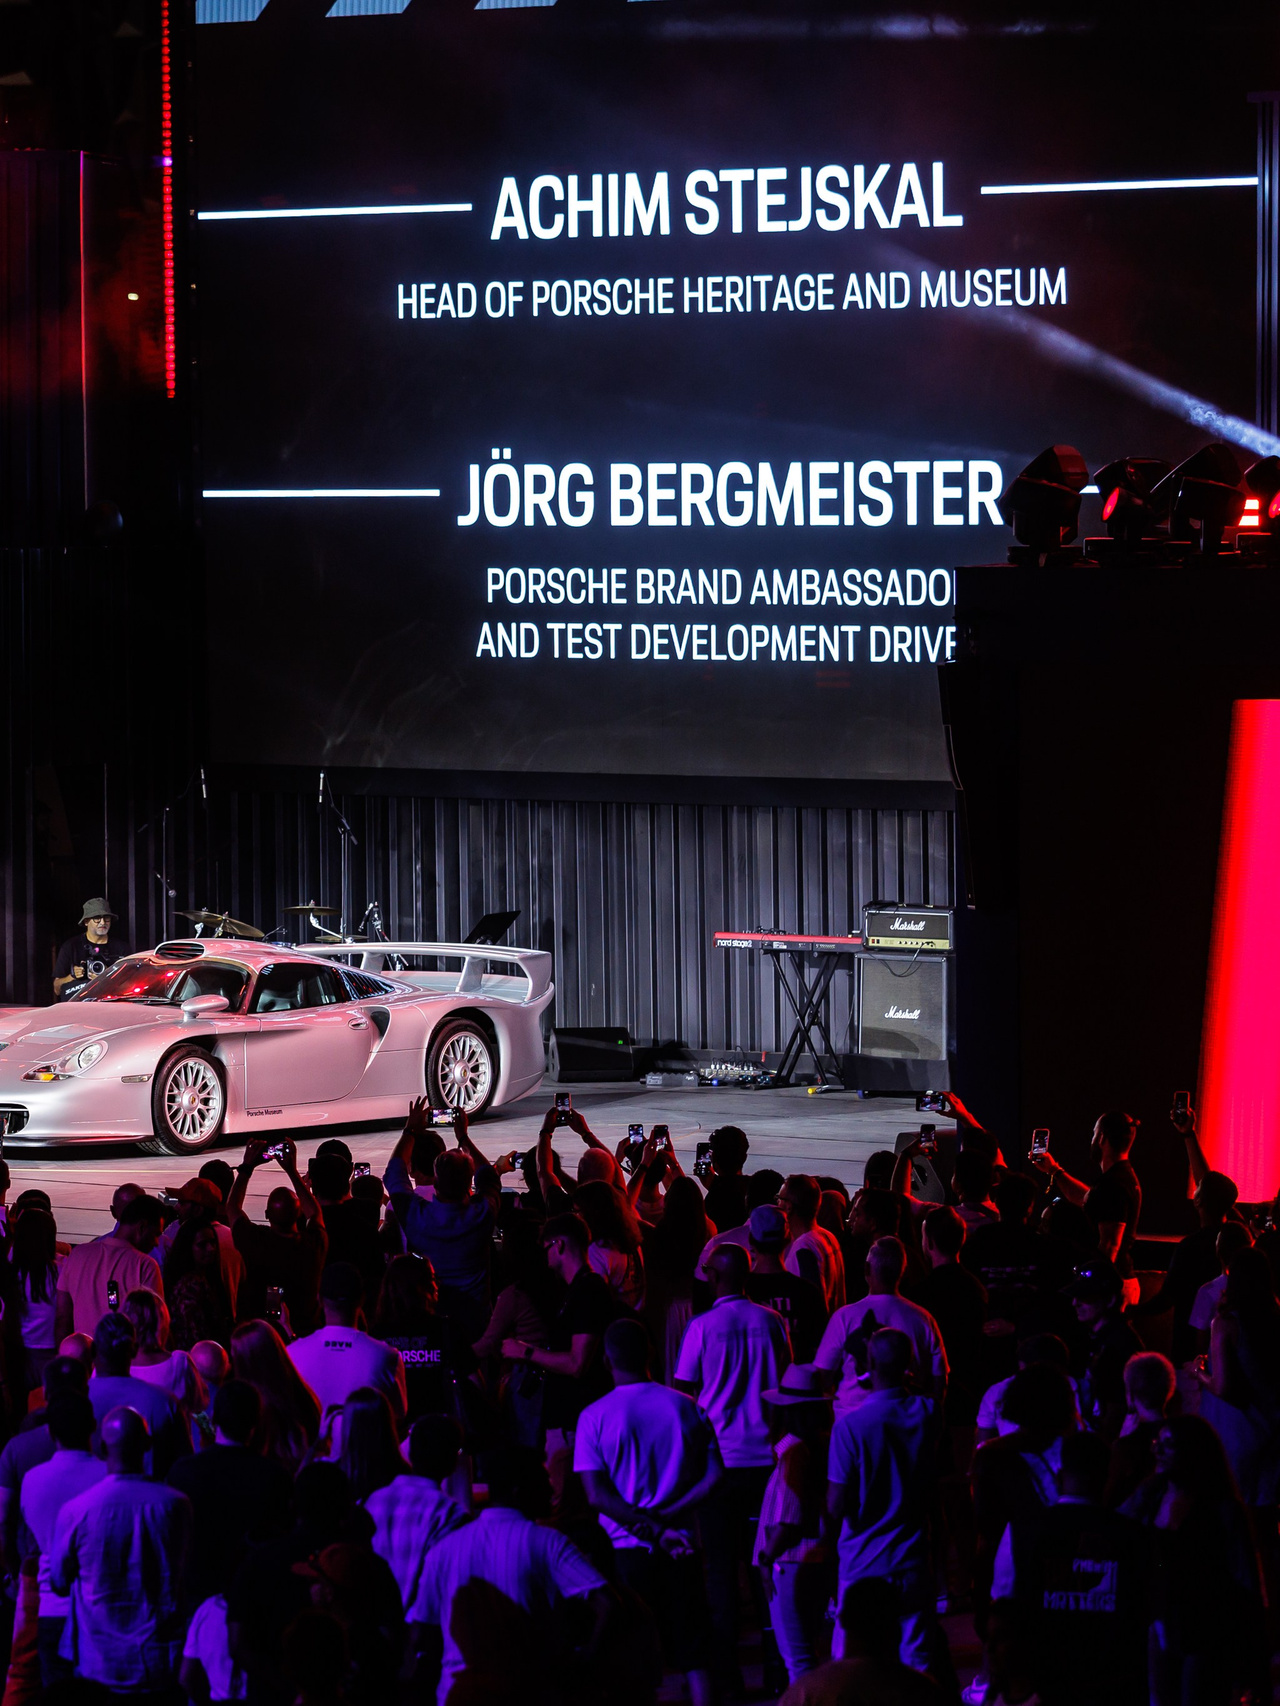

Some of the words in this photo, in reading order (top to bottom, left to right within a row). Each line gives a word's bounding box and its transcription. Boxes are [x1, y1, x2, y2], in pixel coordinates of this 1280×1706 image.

[491, 172, 670, 240] ACHIM
[685, 162, 963, 235] STEJSKAL
[398, 283, 476, 319] HEAD
[485, 281, 523, 318] OF
[533, 278, 674, 316] PORSCHE
[684, 274, 834, 313] HERITAGE
[843, 272, 910, 309] AND
[921, 268, 1066, 308] MUSEUM
[458, 448, 594, 527] JÖRG
[611, 460, 1004, 527] BERGMEISTER
[487, 567, 627, 604] PORSCHE
[637, 568, 742, 605] BRAND
[750, 568, 956, 606] AMBASSADO
[476, 622, 539, 657] AND
[547, 623, 622, 659] TEST
[631, 624, 860, 661] DEVELOPMENT
[889, 917, 926, 932] Marshall
[884, 1005, 921, 1020] Marshall
